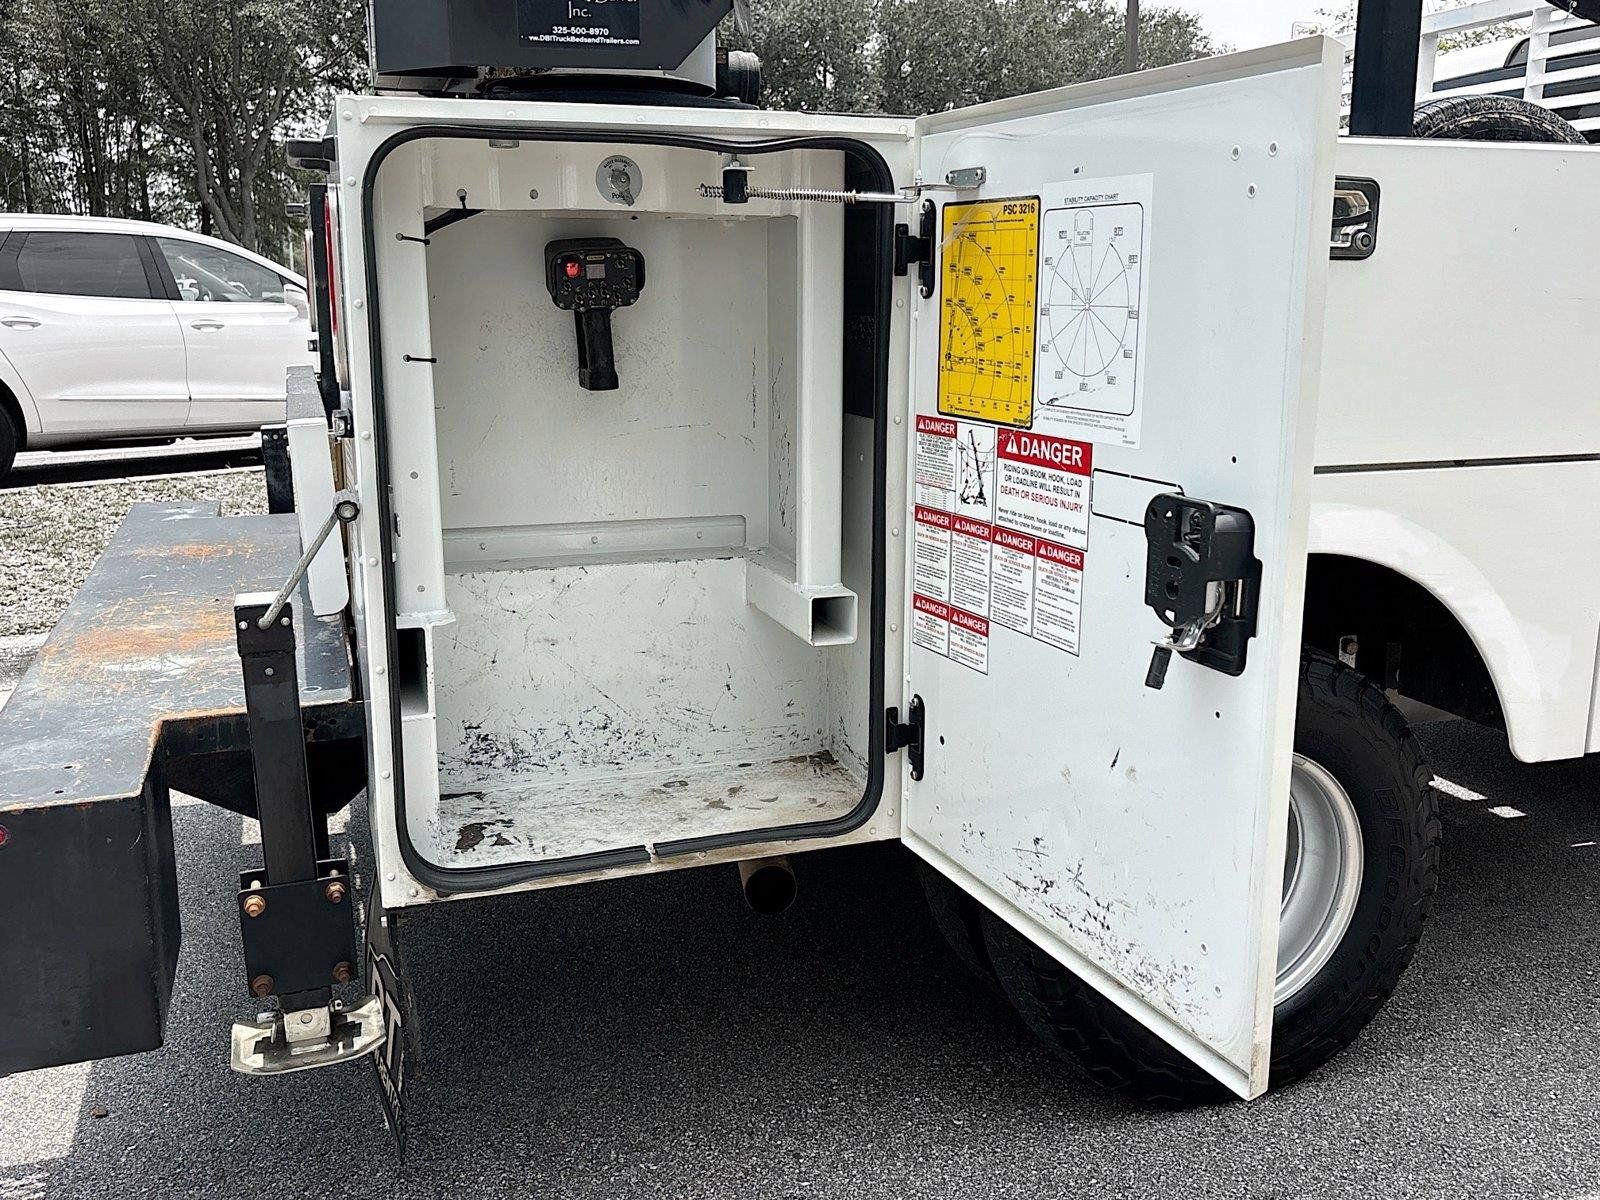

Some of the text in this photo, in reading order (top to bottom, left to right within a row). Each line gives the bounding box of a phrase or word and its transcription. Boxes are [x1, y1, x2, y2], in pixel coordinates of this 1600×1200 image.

[568, 1, 592, 18] Inc.
[552, 26, 609, 36] 325-500-8970
[1003, 202, 1035, 215] PSC 3216
[926, 420, 955, 434] DANGER
[1020, 436, 1082, 468] DANGER
[1004, 464, 1020, 474] RIDING
[1067, 478, 1082, 487] LOAD
[1004, 474, 1080, 498] OR LOADLINE WILL RESULT IN
[1000, 485, 1083, 513] DEATH OR SERIOUS INJURY
[924, 511, 950, 526] DANGER
[962, 521, 990, 537] DANGER
[1002, 533, 1033, 551] DANGER
[1047, 546, 1080, 566] DANGER
[922, 600, 947, 617] DANGER
[959, 614, 986, 633] DANGER
